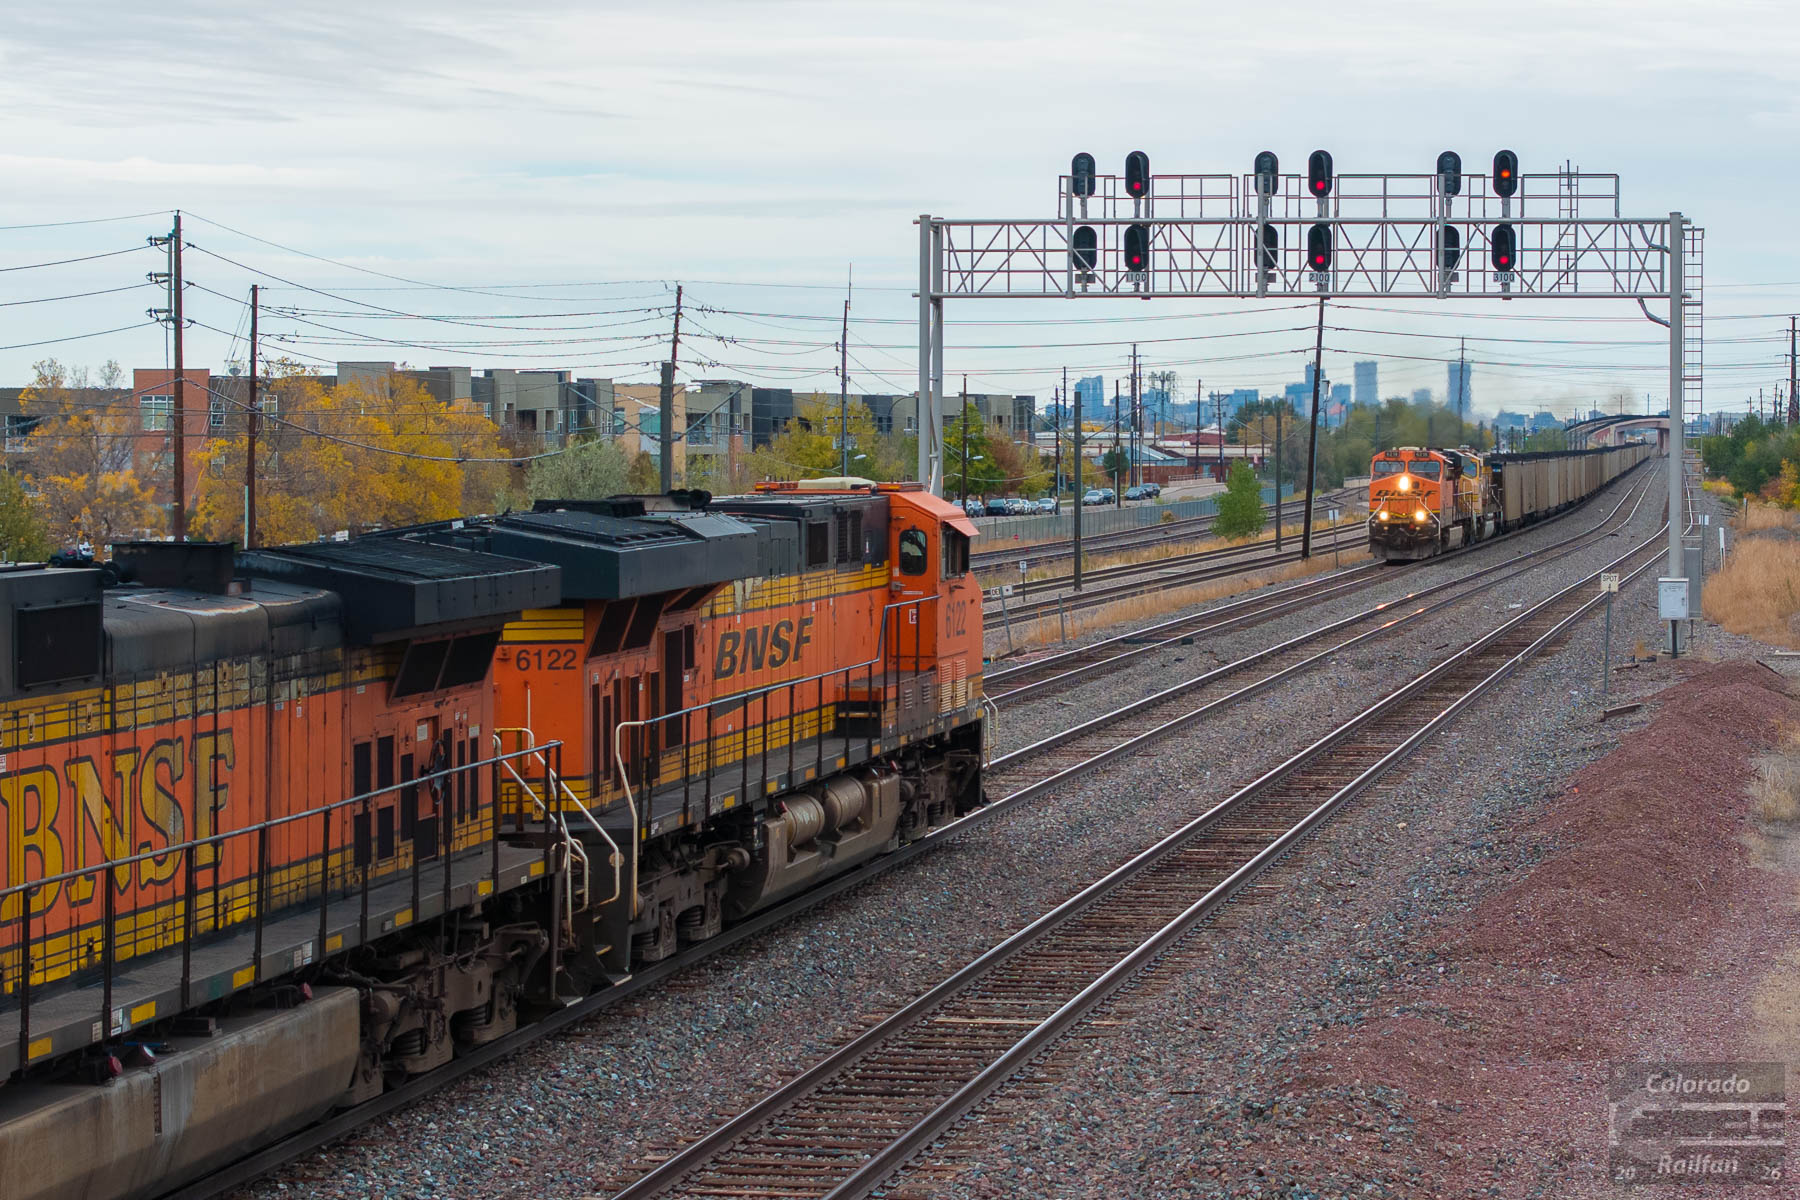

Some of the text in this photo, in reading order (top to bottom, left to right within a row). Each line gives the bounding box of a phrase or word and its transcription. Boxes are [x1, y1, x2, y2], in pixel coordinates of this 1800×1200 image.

[1309, 272, 1330, 282] 2100
[1494, 272, 1515, 282] 3100
[1603, 574, 1617, 582] SPOT
[945, 600, 966, 639] 6122
[516, 648, 577, 671] 6122
[715, 616, 814, 681] BNSF
[0, 727, 235, 928] BNSF
